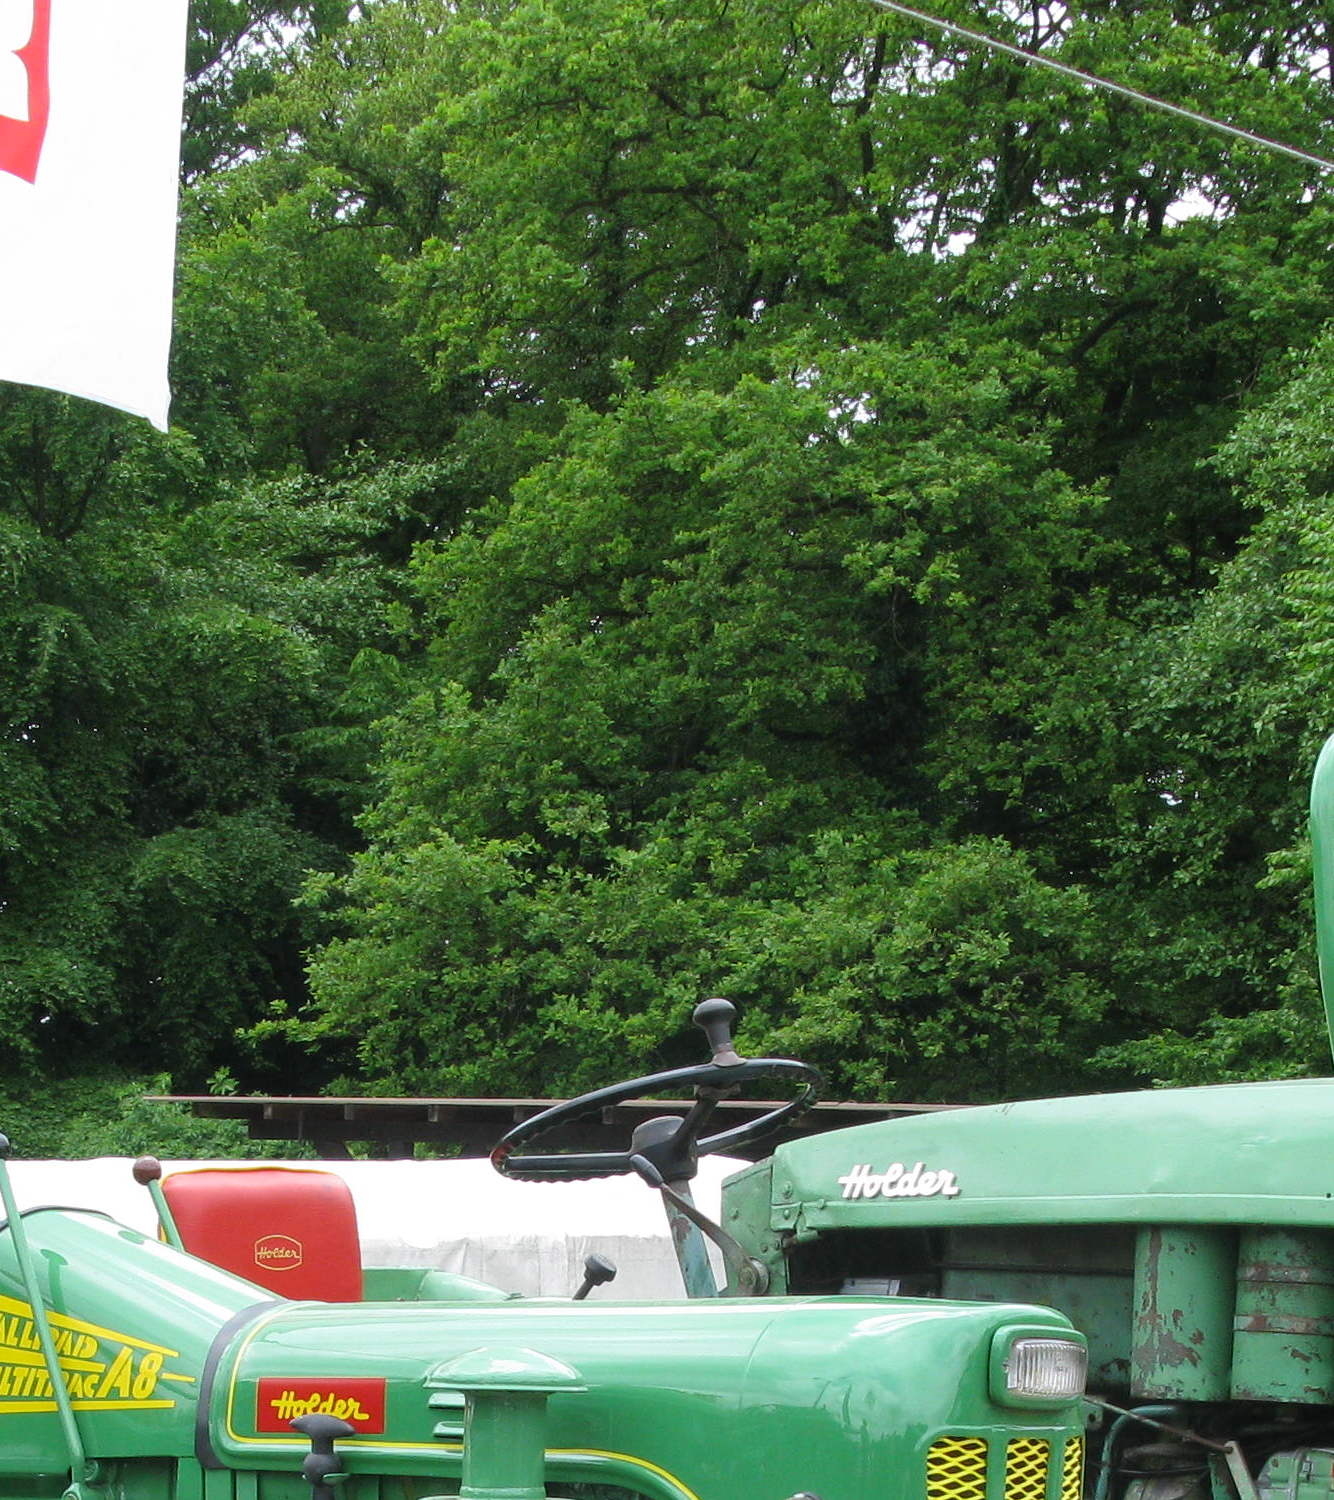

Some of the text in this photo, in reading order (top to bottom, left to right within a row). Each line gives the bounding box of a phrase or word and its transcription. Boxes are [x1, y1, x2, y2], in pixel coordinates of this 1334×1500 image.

[837, 1161, 961, 1198] Holder
[257, 1246, 301, 1260] Holder
[94, 1345, 164, 1400] A8
[270, 1390, 370, 1420] Holder
